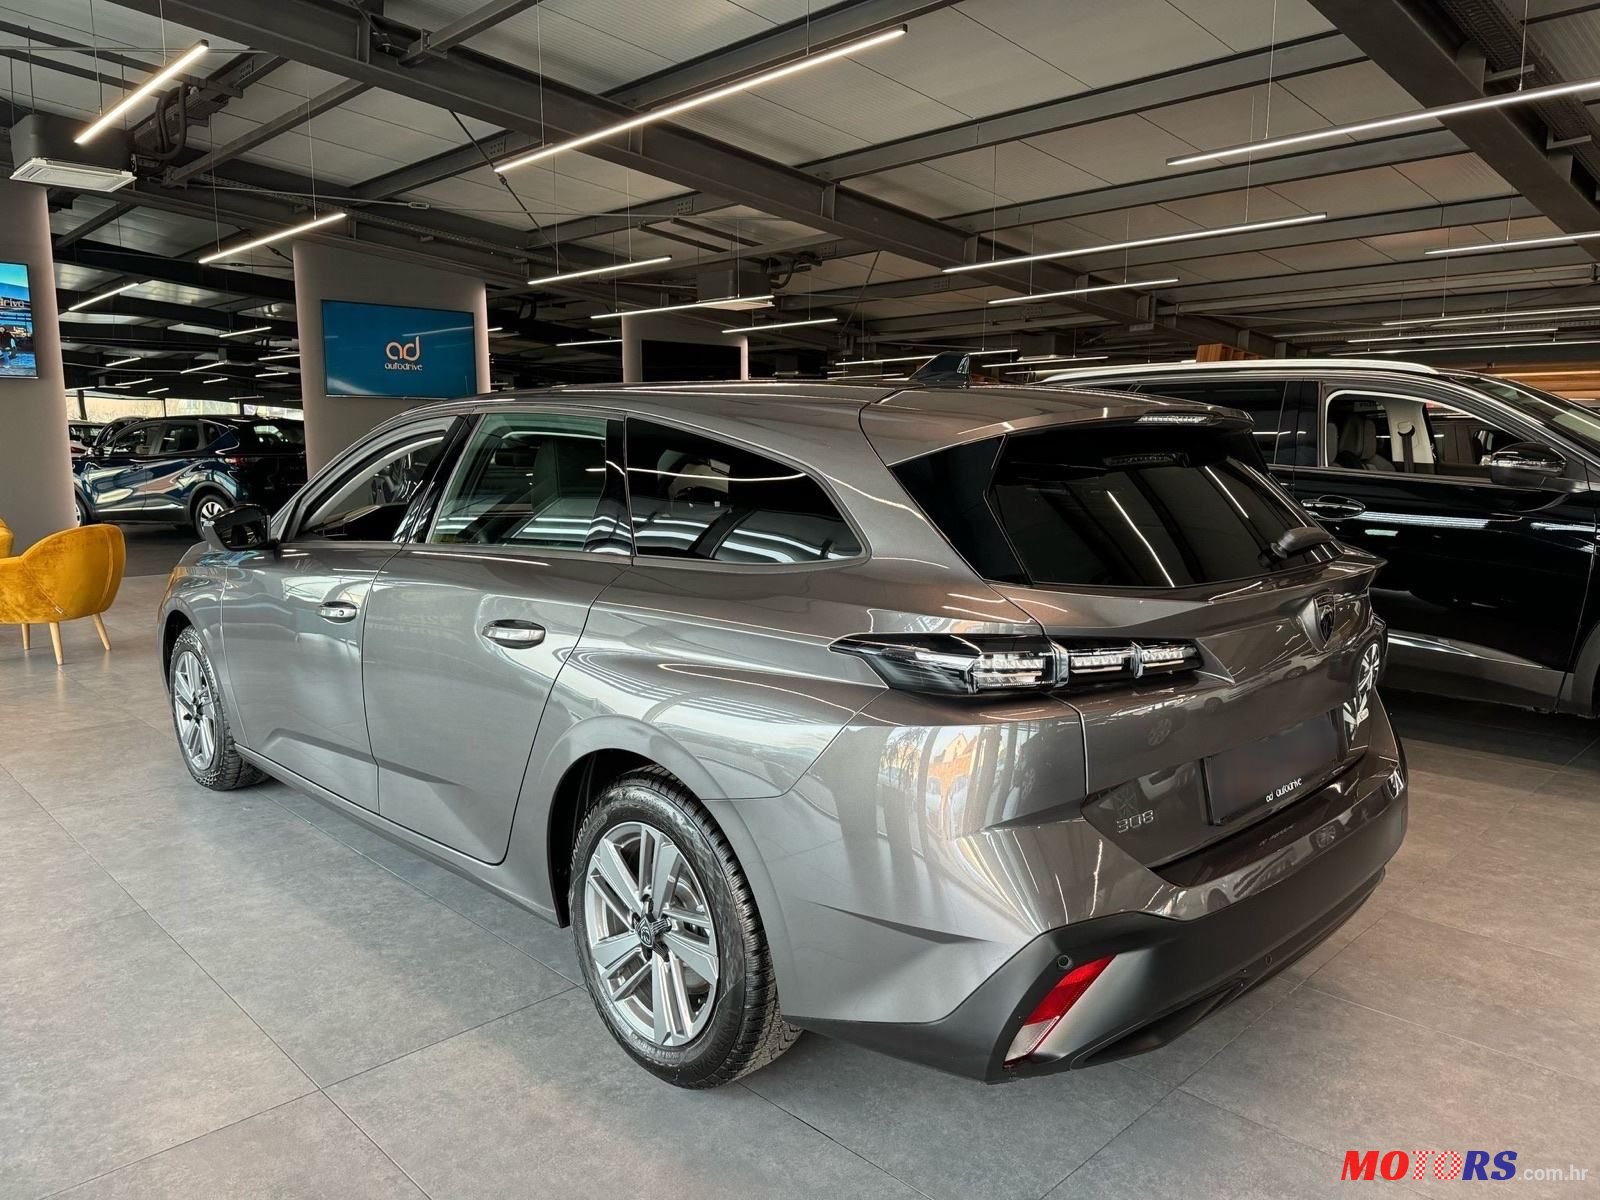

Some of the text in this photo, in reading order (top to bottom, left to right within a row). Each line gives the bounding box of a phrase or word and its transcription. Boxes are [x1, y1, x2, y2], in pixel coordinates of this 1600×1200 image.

[386, 336, 420, 361] ad
[384, 362, 423, 371] autodrive
[1275, 777, 1302, 798] autodrive
[1116, 809, 1154, 834] 308
